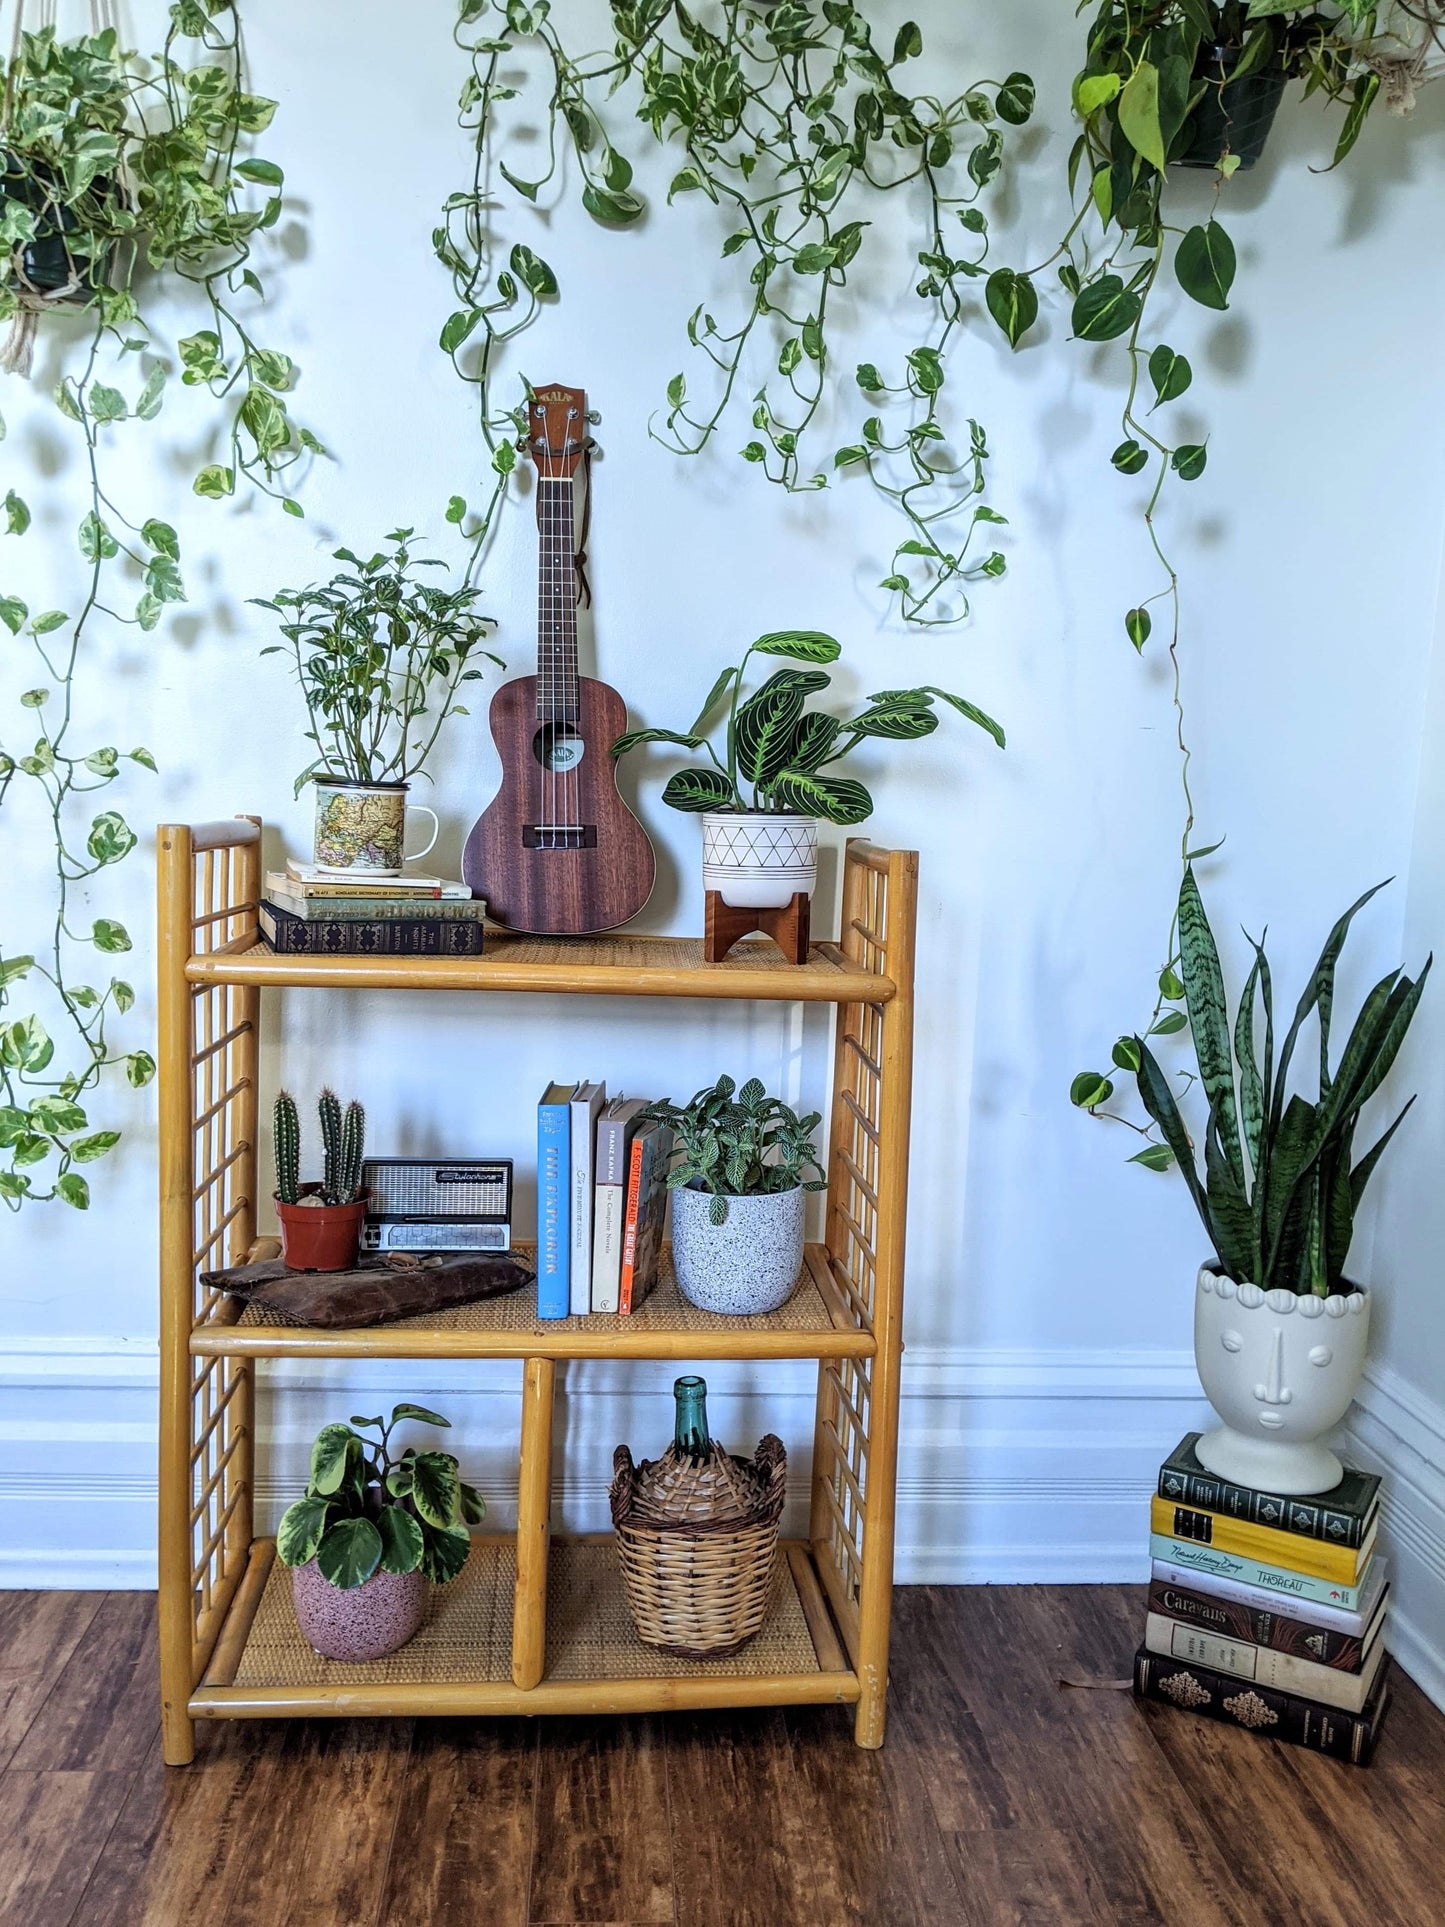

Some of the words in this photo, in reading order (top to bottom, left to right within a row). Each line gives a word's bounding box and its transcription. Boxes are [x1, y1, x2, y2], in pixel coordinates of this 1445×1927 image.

[541, 391, 573, 401] KALA
[375, 905, 446, 918] FORSTER
[546, 1146, 558, 1180] THE
[632, 1154, 641, 1177] SCOTT
[628, 1179, 639, 1224] FITZGERALD
[546, 1185, 558, 1274] EXPLORER
[605, 1203, 613, 1231] Complete
[1258, 1570, 1314, 1592] THOREAU
[1164, 1591, 1228, 1623] Caravans
